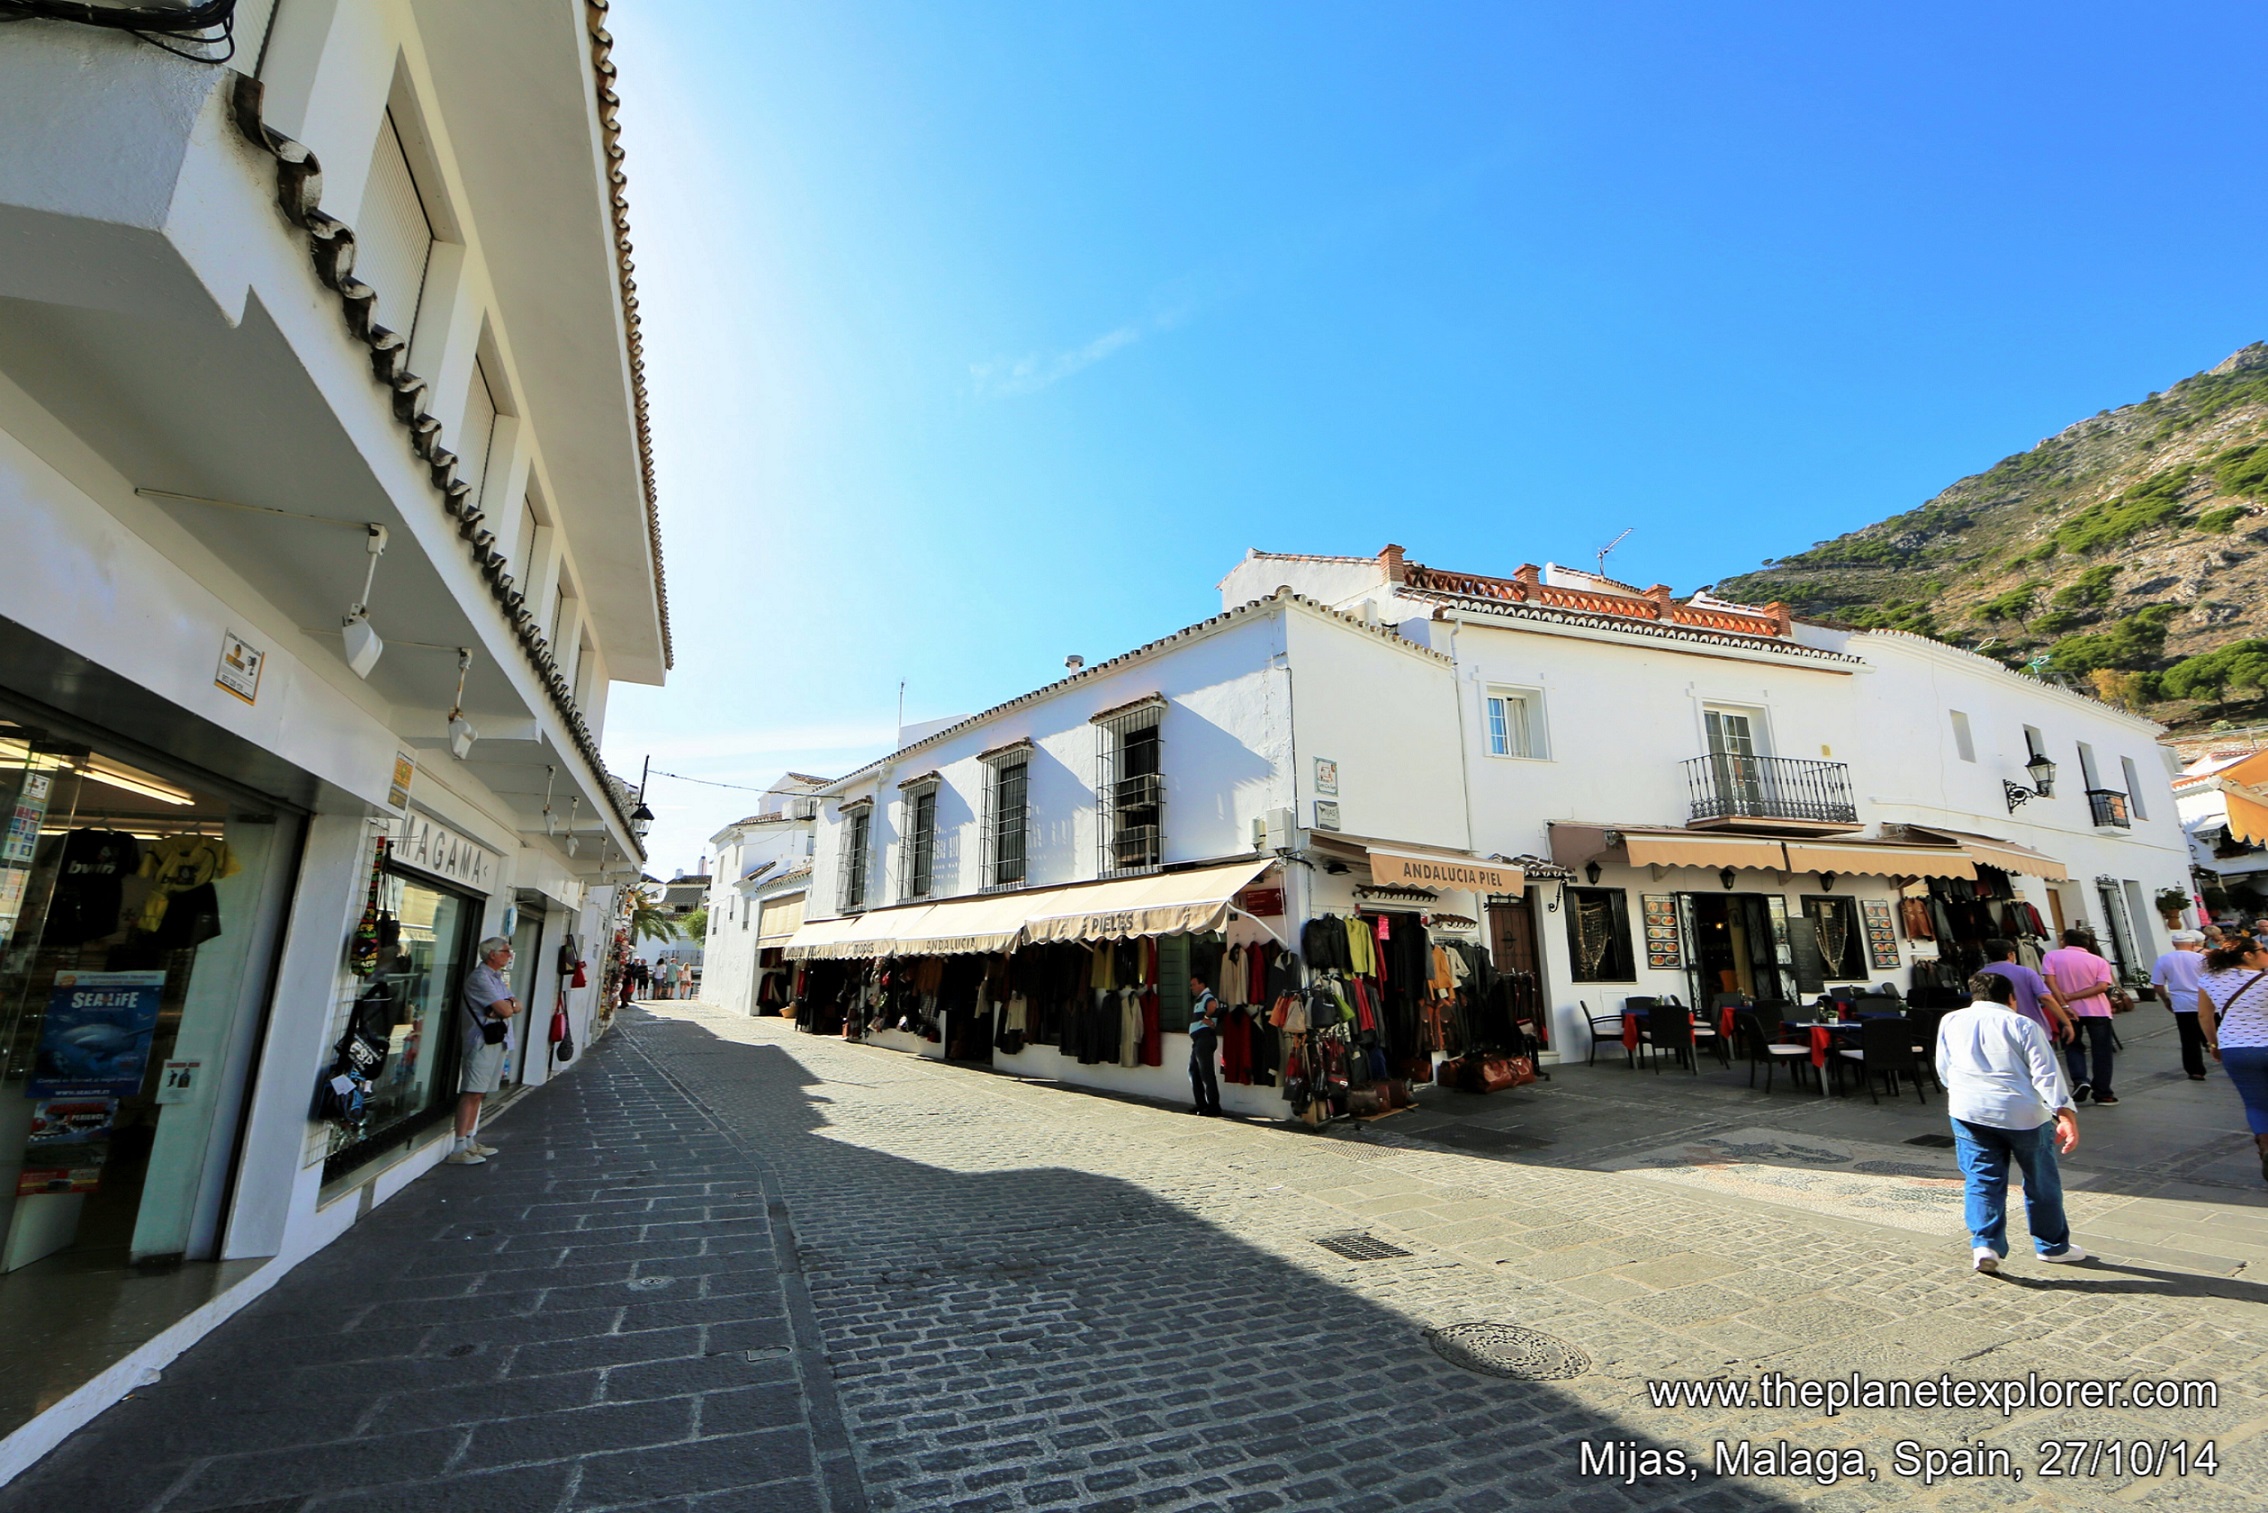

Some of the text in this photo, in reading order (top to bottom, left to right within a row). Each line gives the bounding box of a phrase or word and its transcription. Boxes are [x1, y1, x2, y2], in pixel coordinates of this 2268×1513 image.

[396, 812, 482, 884] MAGAMA
[67, 860, 119, 875] bwin
[1403, 862, 1503, 887] ANDALUCIA PIEL
[1091, 912, 1135, 934] PIELES
[926, 937, 976, 951] ANDALUCIA
[71, 991, 103, 1009] SEA
